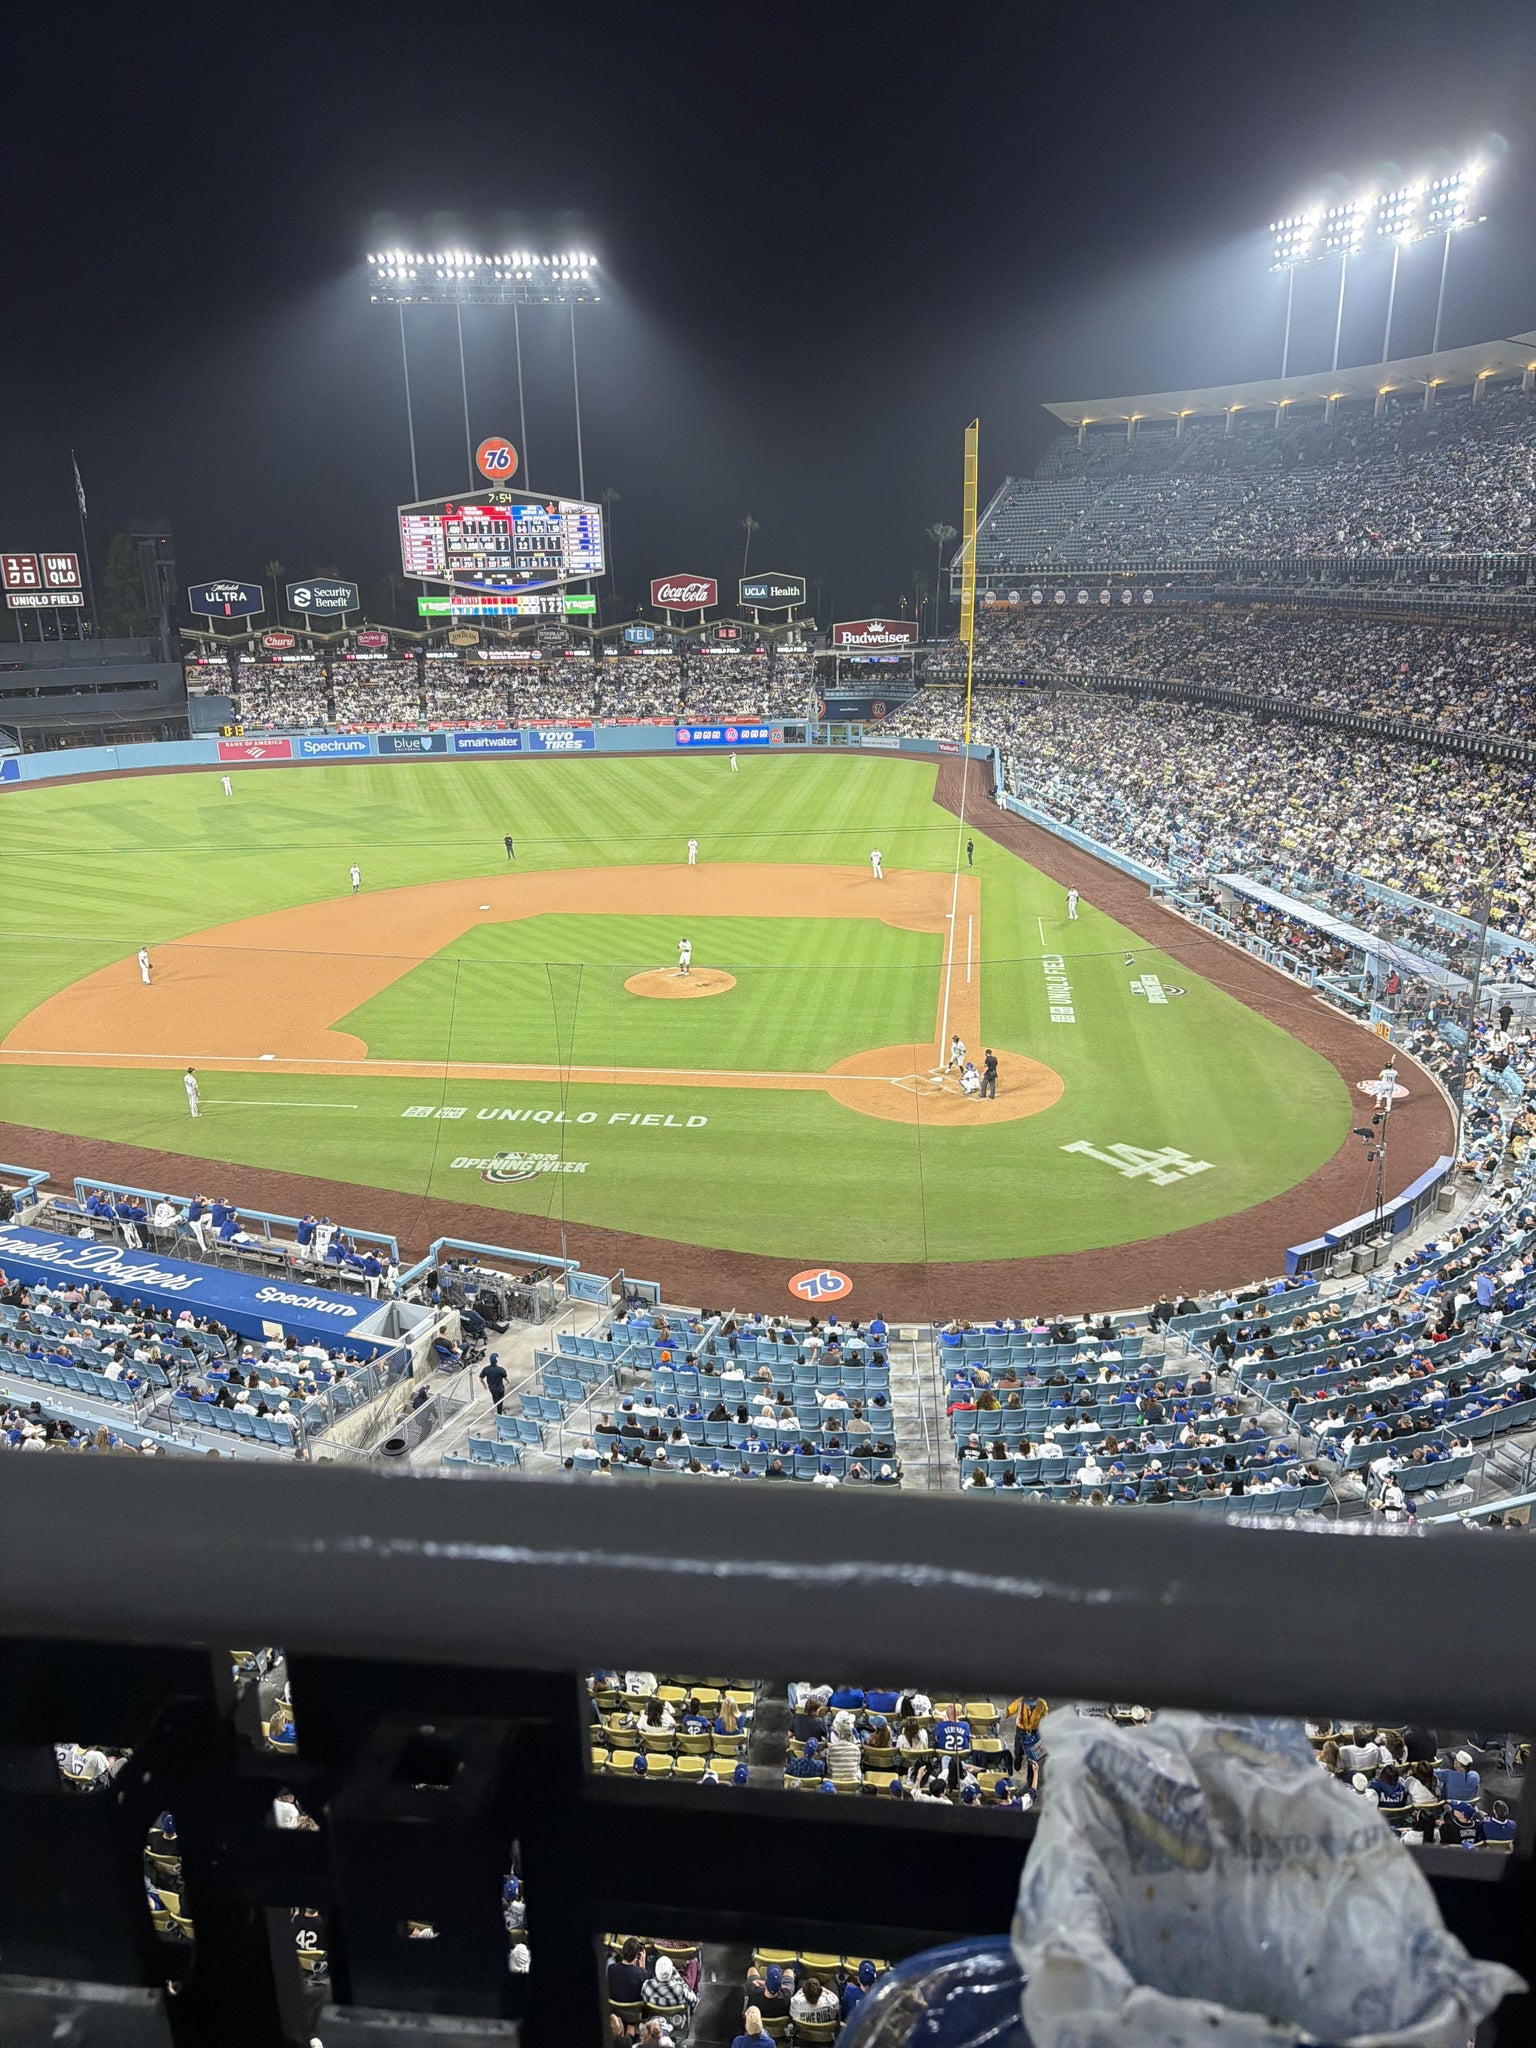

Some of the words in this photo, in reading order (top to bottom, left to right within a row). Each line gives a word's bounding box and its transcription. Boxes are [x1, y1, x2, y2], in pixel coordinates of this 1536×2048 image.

[483, 447, 511, 470] 76
[488, 493, 512, 504] 7:54
[8, 558, 34, 570] ユニ
[47, 558, 72, 570] UNI
[10, 572, 36, 584] クロ
[50, 571, 76, 584] QLO
[206, 592, 248, 602] ULTRA
[314, 587, 352, 600] Security
[657, 582, 710, 602] Coca-Cola
[744, 587, 766, 596] UCLA
[770, 586, 800, 596] Health
[12, 596, 49, 606] UNIQLO
[50, 594, 80, 604] FIELD
[316, 598, 348, 608] Benefit
[548, 602, 555, 612] 2
[556, 602, 562, 612] 2
[628, 627, 651, 640] TEL
[842, 632, 910, 644] Budweiser
[264, 636, 294, 646] Churu
[874, 704, 886, 714] 76
[224, 725, 244, 737] 0:13
[538, 732, 574, 741] TOYO
[772, 731, 782, 740] 76
[304, 740, 360, 754] Spectrum
[394, 738, 420, 748] blue
[458, 737, 518, 748] smartwater
[544, 740, 583, 750] TIRES
[939, 744, 960, 752] Yakult
[1042, 954, 1066, 974] FIELD
[1045, 976, 1073, 1004] UNIQLO
[475, 1108, 598, 1124] UNIQLO
[607, 1113, 708, 1128] FIELD
[450, 1157, 535, 1170] OPENING
[534, 1160, 590, 1173] WEEK
[1058, 1140, 1216, 1187] LA
[66, 1244, 203, 1292] Dodgers
[797, 1271, 845, 1300] 76
[255, 1286, 354, 1316] Spectrum
[631, 1684, 640, 1694] 5
[687, 1726, 701, 1736] 42
[945, 1735, 964, 1750] 22
[296, 1930, 318, 1950] 42
[805, 2012, 815, 2023] WE
